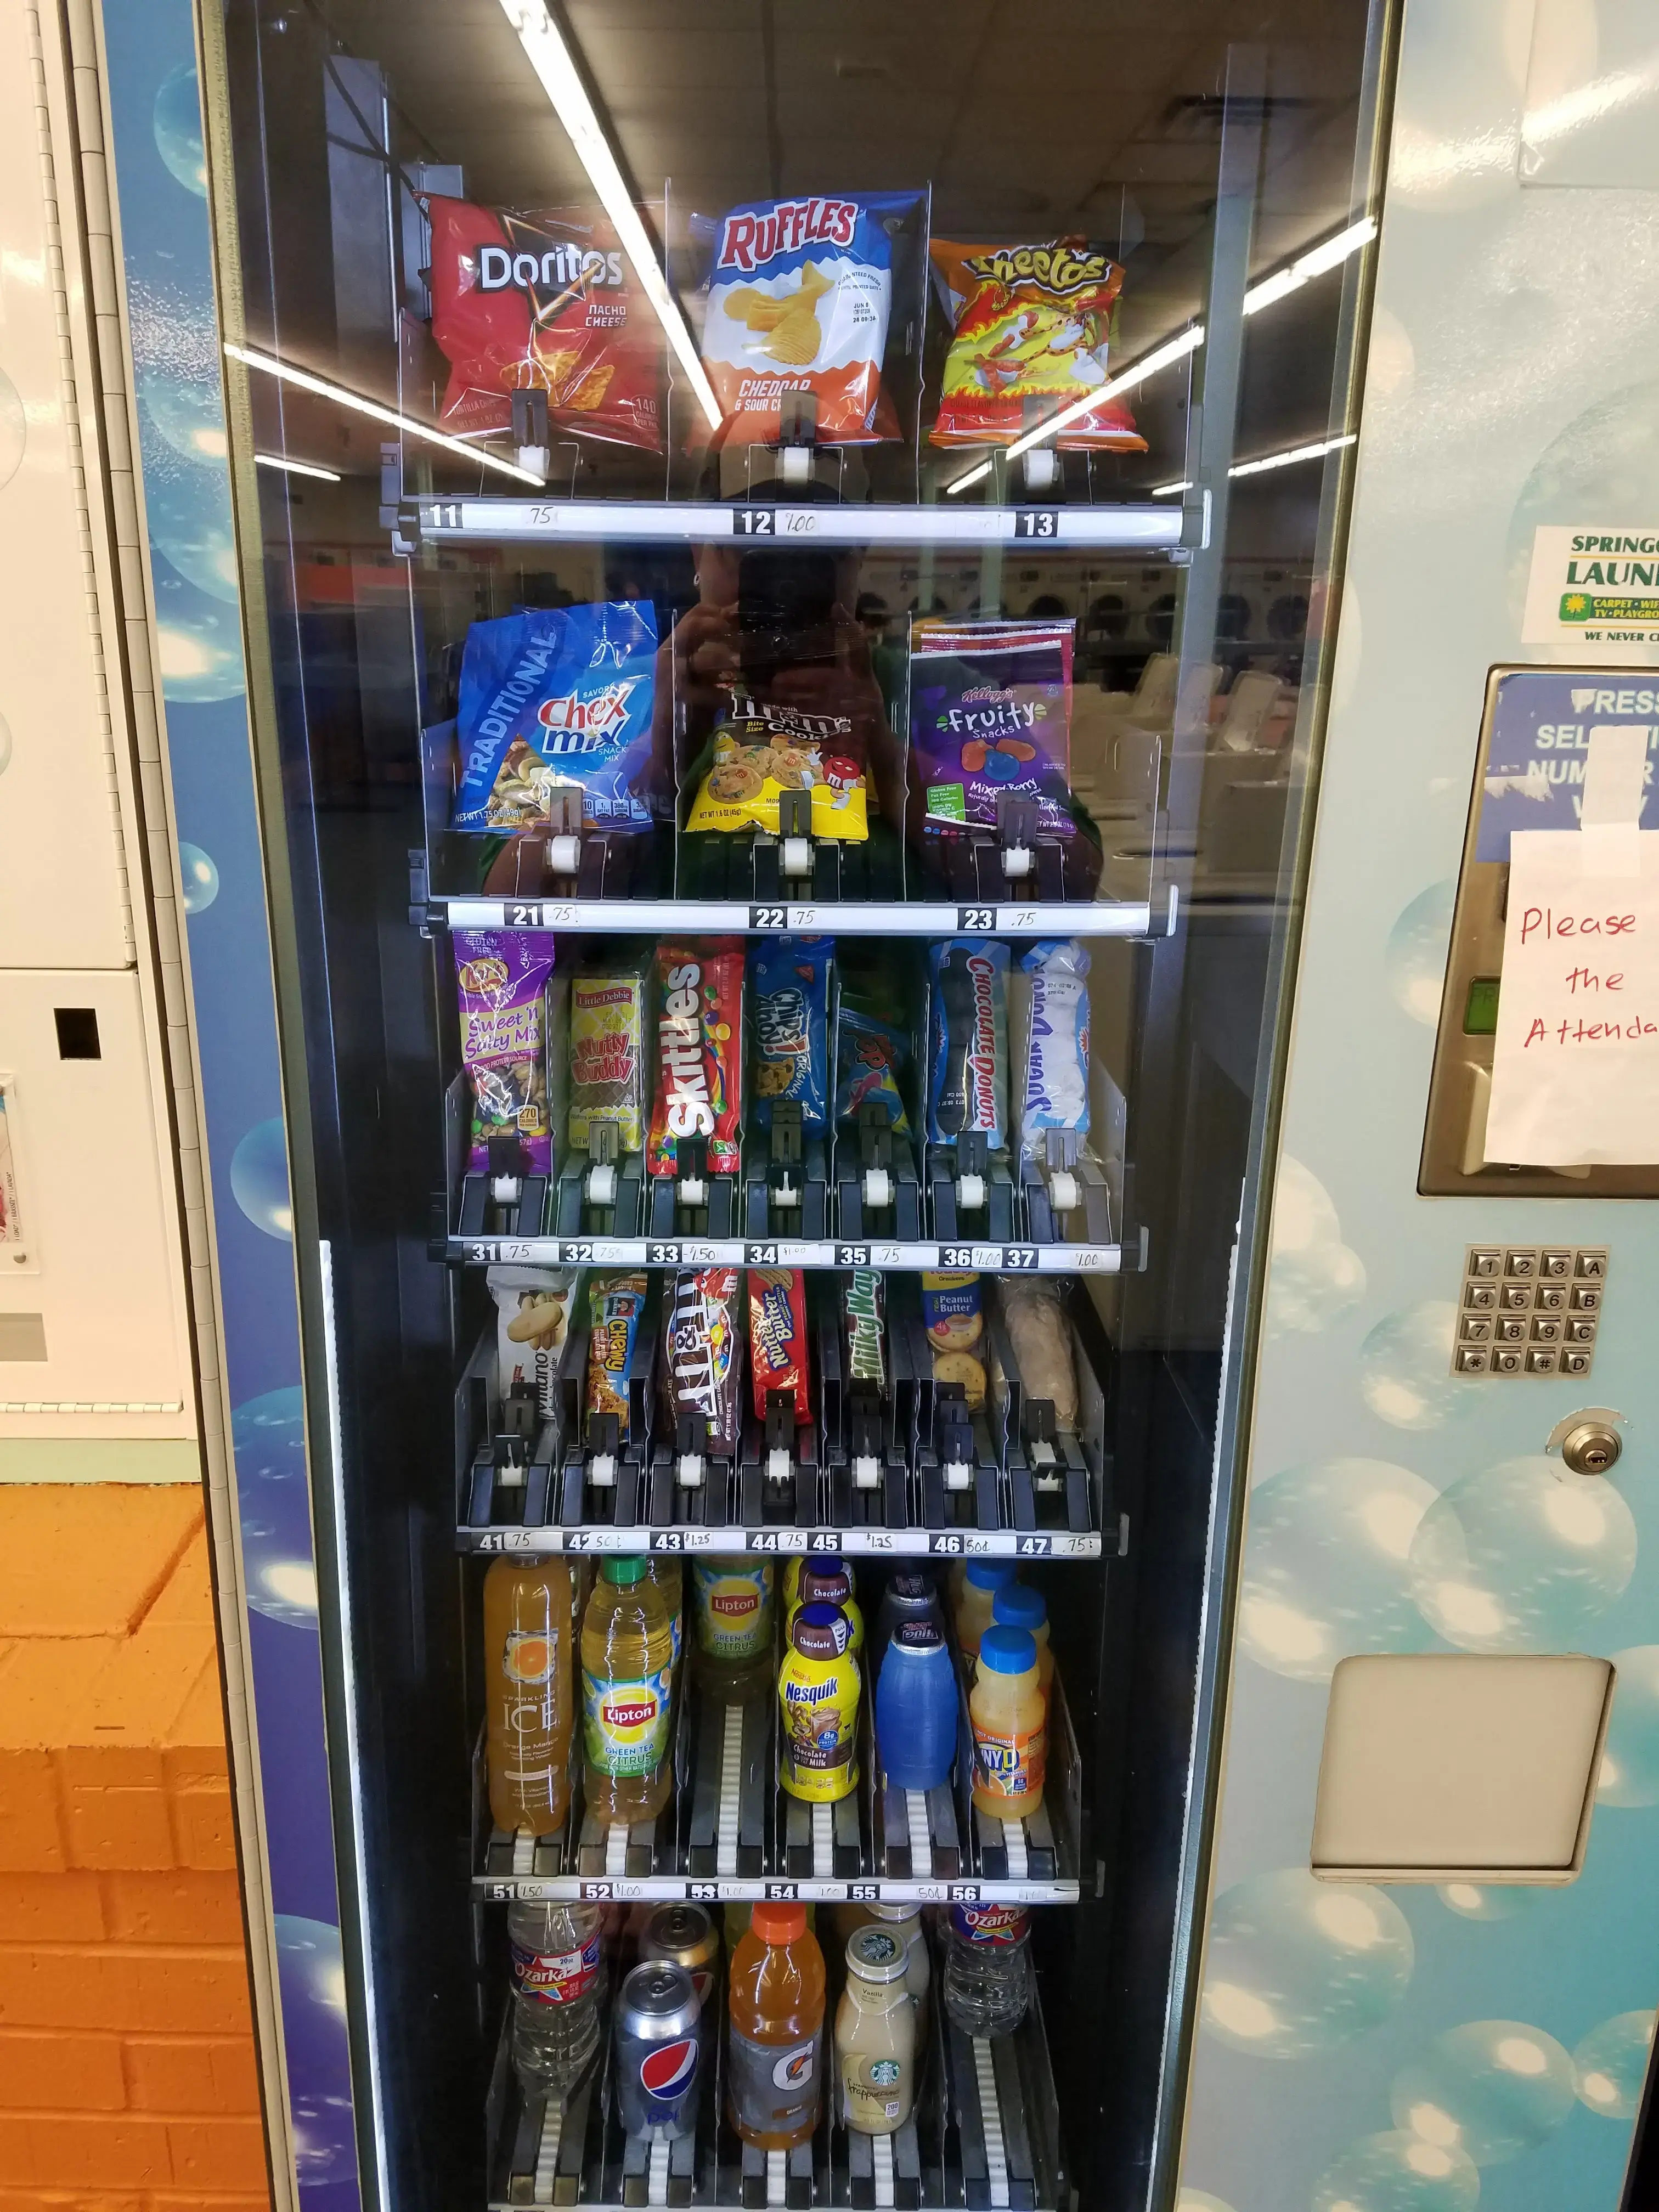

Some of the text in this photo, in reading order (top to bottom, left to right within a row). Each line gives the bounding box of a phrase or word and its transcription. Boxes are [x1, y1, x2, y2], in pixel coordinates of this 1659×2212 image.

[719, 199, 856, 270] RUFFLES
[480, 243, 623, 289] Doritos
[588, 304, 627, 316] NACHO
[585, 316, 627, 328] CHEESE
[636, 398, 656, 414] 140
[735, 399, 742, 411] &
[744, 399, 769, 411] SOUR
[430, 504, 459, 527] 11
[742, 511, 771, 534] 12
[1023, 513, 1054, 537] 13
[1593, 599, 1633, 608] CARPET
[1594, 609, 1607, 618] TV
[1585, 631, 1645, 641] WE NEVER
[961, 685, 1014, 703] Kellogg's
[460, 636, 556, 788] TRADITIONAL
[540, 687, 629, 730] Chex
[947, 702, 1035, 733] fruity
[546, 723, 622, 752] mix
[972, 725, 1015, 740] Snacks
[598, 746, 627, 757] SNACK
[603, 754, 619, 763] MIX
[455, 806, 521, 822] NET WT 1.75 OZ (49g)
[730, 808, 742, 817] (45g)
[512, 906, 540, 926] 21
[755, 909, 816, 929] 22 .75
[964, 909, 1037, 930] 23 .75
[1520, 907, 1637, 945] Please
[1565, 967, 1624, 994] the
[579, 990, 630, 1006] Little Debbie
[967, 957, 996, 1055] CHOCOLATE
[469, 1006, 538, 1037] Sweet 'n
[515, 1025, 541, 1043] Mix
[1523, 1015, 1659, 1048] Attenda
[577, 1033, 629, 1059] Nutty
[659, 963, 714, 1137] Skittles
[572, 1056, 633, 1083] Buddy
[786, 1054, 807, 1098] ORIGINAL
[967, 1053, 995, 1130] DONUTS
[520, 1108, 537, 1119] 270
[472, 1244, 532, 1261] 31 .75
[565, 1245, 592, 1262] 32
[652, 1245, 679, 1262] 33
[749, 1245, 806, 1263] 34 $1.00
[840, 1247, 901, 1265] 35 .75
[944, 1248, 971, 1267] 36
[1007, 1249, 1034, 1268] 37
[1487, 1261, 1493, 1273] 1
[1519, 1261, 1530, 1274] 2
[1554, 1262, 1565, 1275] 3
[1589, 1262, 1601, 1275] A
[939, 1295, 973, 1304] Peanut
[1479, 1294, 1490, 1306] 4
[1514, 1294, 1525, 1306] 5
[1549, 1294, 1560, 1307] 6
[1584, 1295, 1596, 1307] B
[940, 1304, 970, 1313] Butter
[764, 1292, 793, 1341] Butter
[847, 1269, 884, 1384] Milky Way
[1475, 1325, 1486, 1338] 7
[1509, 1325, 1521, 1338] 8
[1544, 1326, 1555, 1339] 9
[1578, 1327, 1591, 1339] C
[1572, 1358, 1585, 1370] D
[479, 1533, 531, 1550] 41 .75
[568, 1536, 589, 1550] 42
[655, 1533, 710, 1550] 43 $1.25
[751, 1534, 803, 1551] 44 .75
[812, 1533, 893, 1551] 45 $1.25
[934, 1536, 990, 1553] 46 50¢
[1022, 1538, 1086, 1555] 47 .75
[814, 1587, 847, 1598] Chocolate
[715, 1597, 755, 1612] Lipton
[834, 1623, 847, 1634] PULL
[713, 1632, 757, 1642] GREEN TEA
[799, 1636, 831, 1649] Chocolate
[715, 1640, 756, 1651] CITRUS
[503, 1690, 556, 1702] SPARKLING
[785, 1678, 838, 1706] Nesquik
[503, 1699, 557, 1733] ICE
[607, 1706, 652, 1724] Lipton
[533, 1737, 559, 1749] Mango
[823, 1731, 834, 1740] 8g
[605, 1742, 654, 1756] GREEN TEA
[793, 1744, 827, 1758] Chocolate
[607, 1752, 652, 1765] CITRUS
[809, 1758, 826, 1767] Milk
[493, 1885, 516, 1899] 51
[586, 1883, 642, 1899] 52 $1.00
[691, 1885, 717, 1898] 53
[770, 1886, 794, 1899] 54
[852, 1886, 943, 1899] 55 50¢
[952, 1887, 977, 1901] 56
[515, 1962, 574, 1983] Ozarka
[862, 1988, 883, 1997] Vanilla
[772, 2040, 814, 2091] G
[786, 2105, 803, 2115] ORANGE
[887, 2102, 898, 2111] 200
